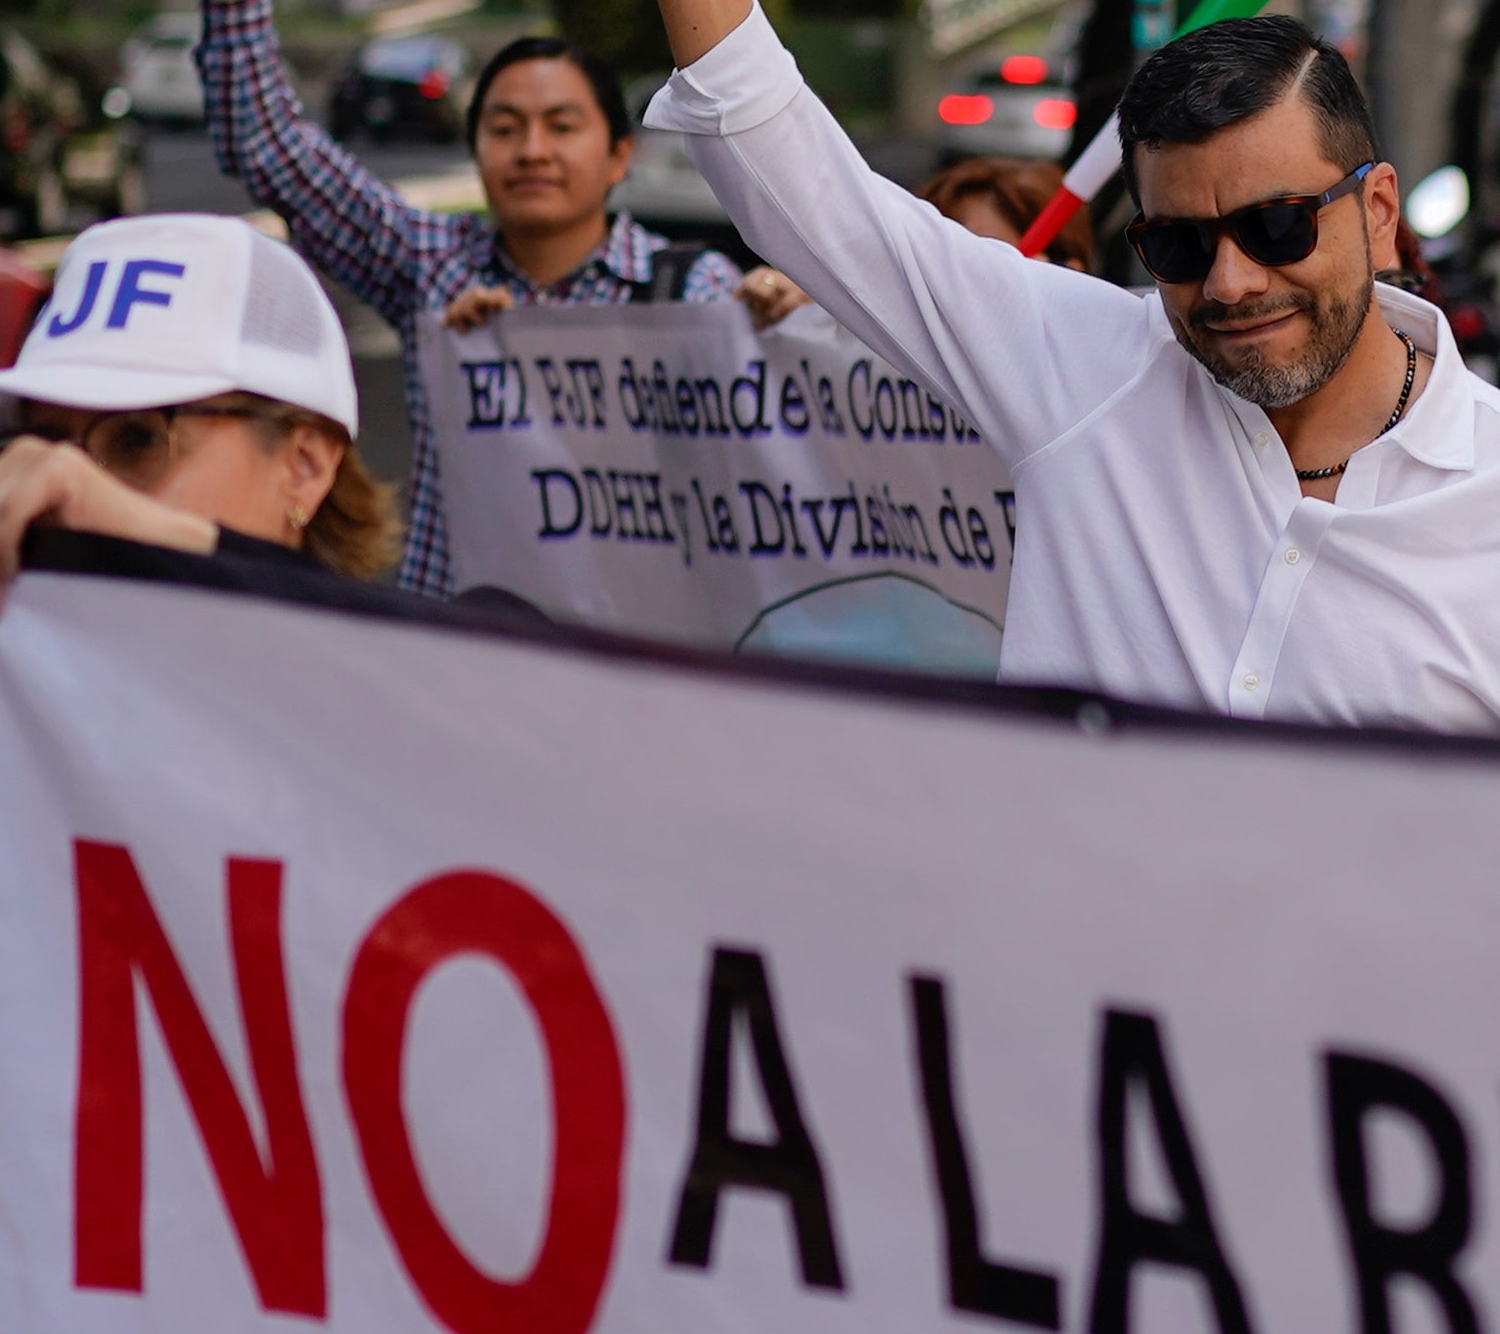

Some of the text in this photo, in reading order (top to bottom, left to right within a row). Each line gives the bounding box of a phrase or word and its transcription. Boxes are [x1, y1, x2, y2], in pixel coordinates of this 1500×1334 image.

[459, 358, 530, 431] El
[691, 478, 740, 554] la
[939, 488, 997, 571] de
[668, 945, 846, 1293] A
